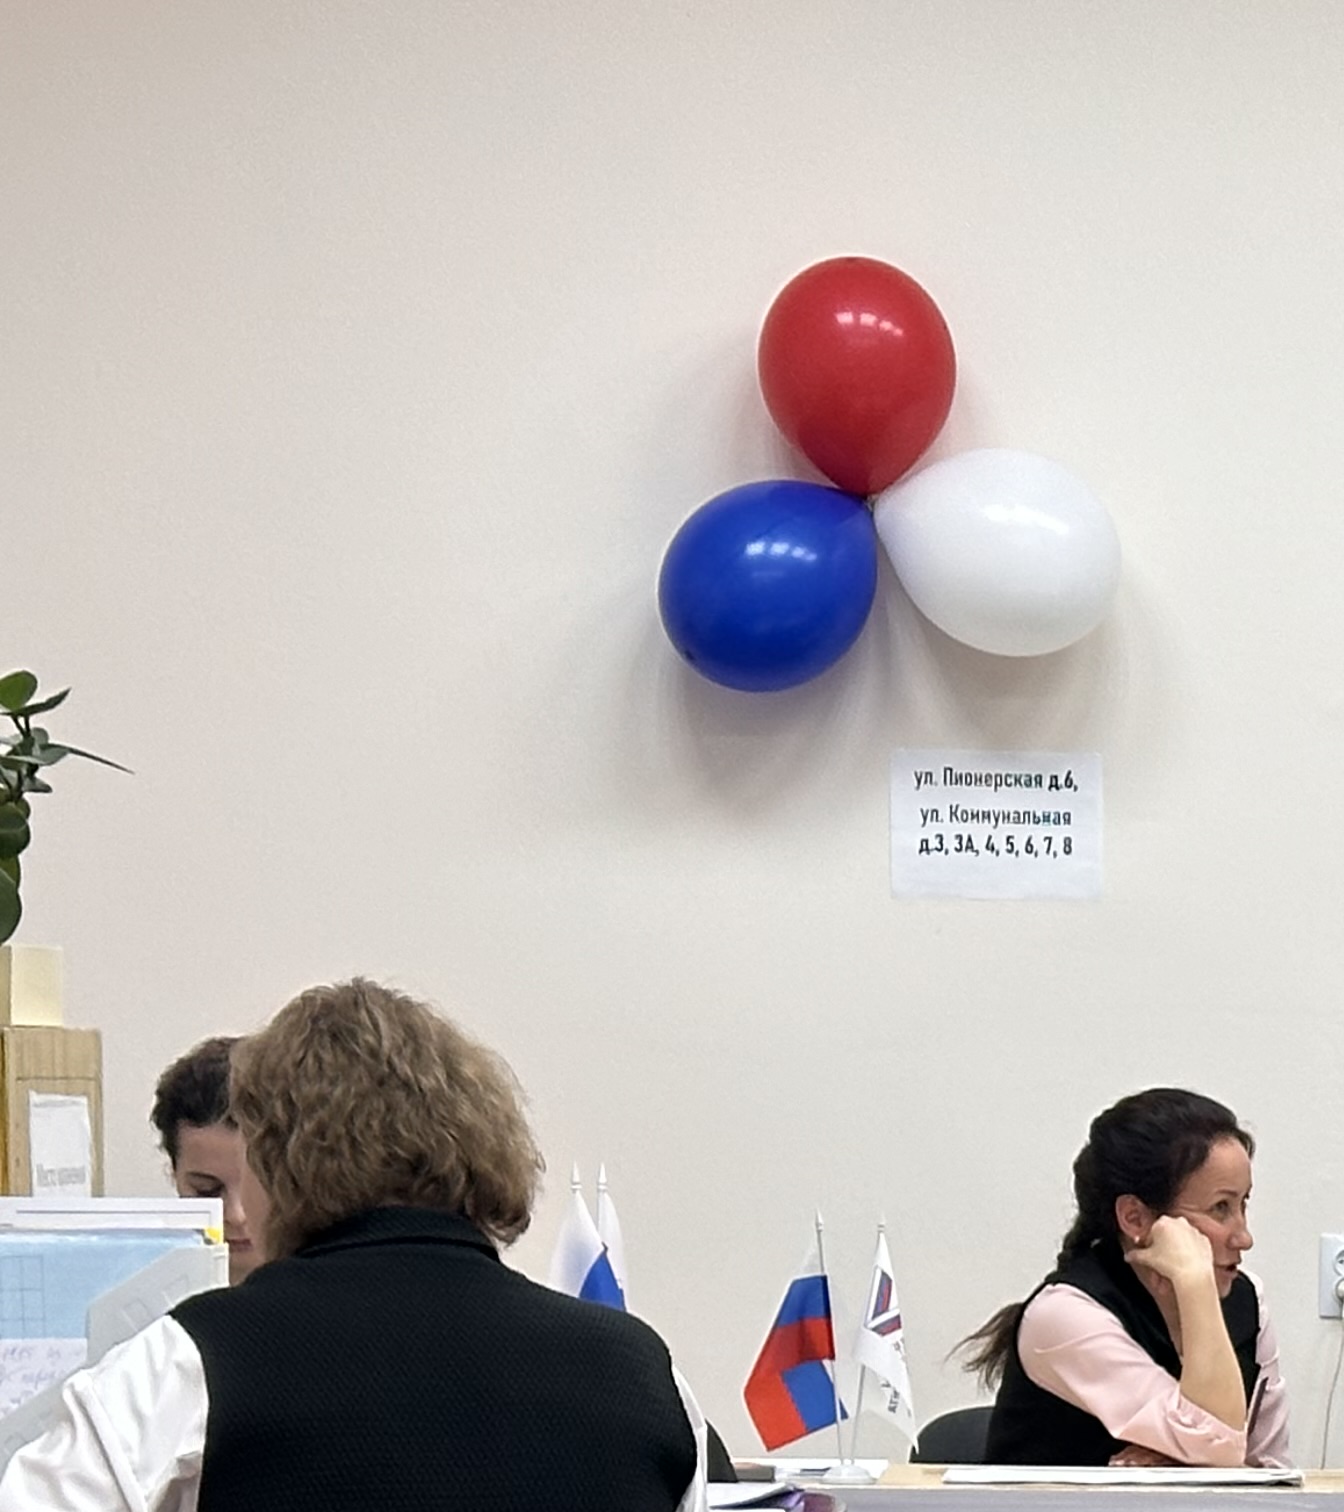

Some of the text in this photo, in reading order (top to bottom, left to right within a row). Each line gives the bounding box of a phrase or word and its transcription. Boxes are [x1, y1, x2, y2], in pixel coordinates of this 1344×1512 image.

[914, 766, 1079, 793] ул. Пионерская д.6,
[920, 803, 1072, 830] ул. Коммунальная
[985, 834, 1000, 857] 4,
[1005, 835, 1020, 858] 5,
[1024, 835, 1039, 858] 6,
[1043, 836, 1058, 859] 7,
[1063, 836, 1073, 856] 8
